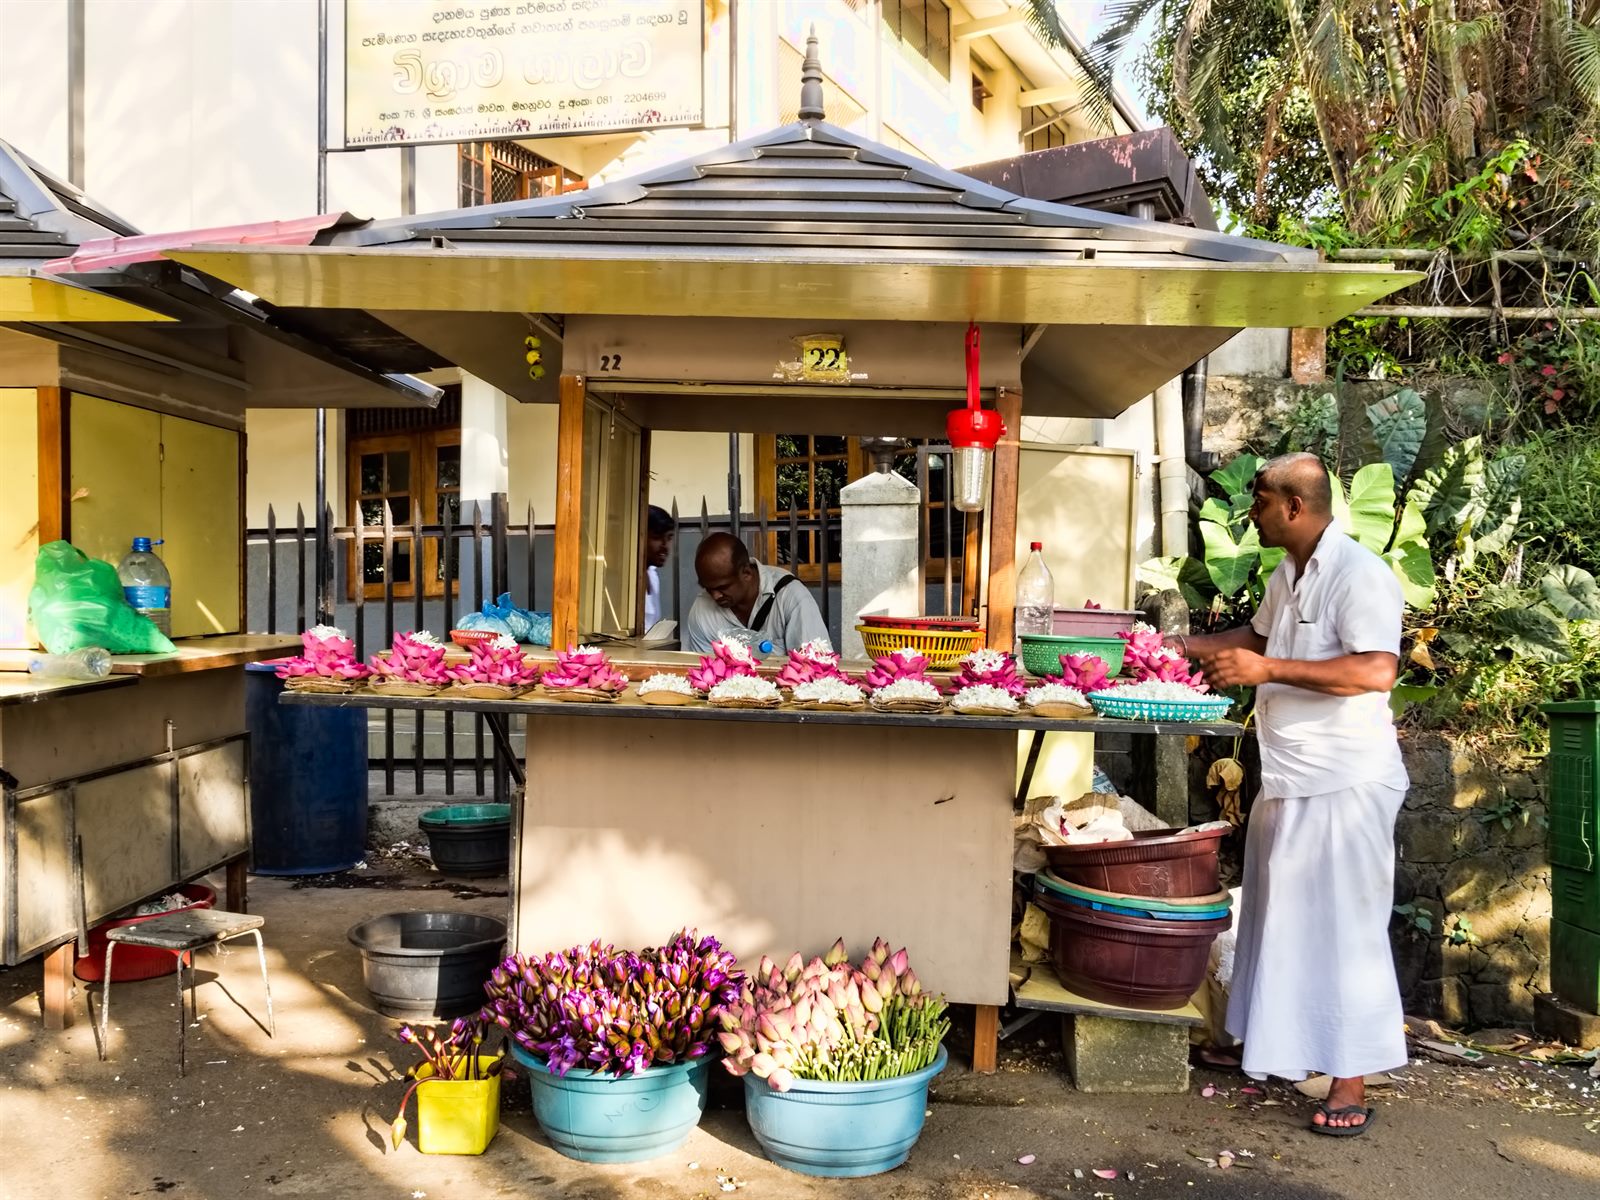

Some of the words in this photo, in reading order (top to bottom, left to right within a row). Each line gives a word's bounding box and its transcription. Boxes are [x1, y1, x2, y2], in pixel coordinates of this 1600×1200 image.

[596, 95, 613, 106] 081
[623, 91, 667, 105] 2204699
[600, 354, 622, 372] 22
[809, 347, 841, 371] 22
